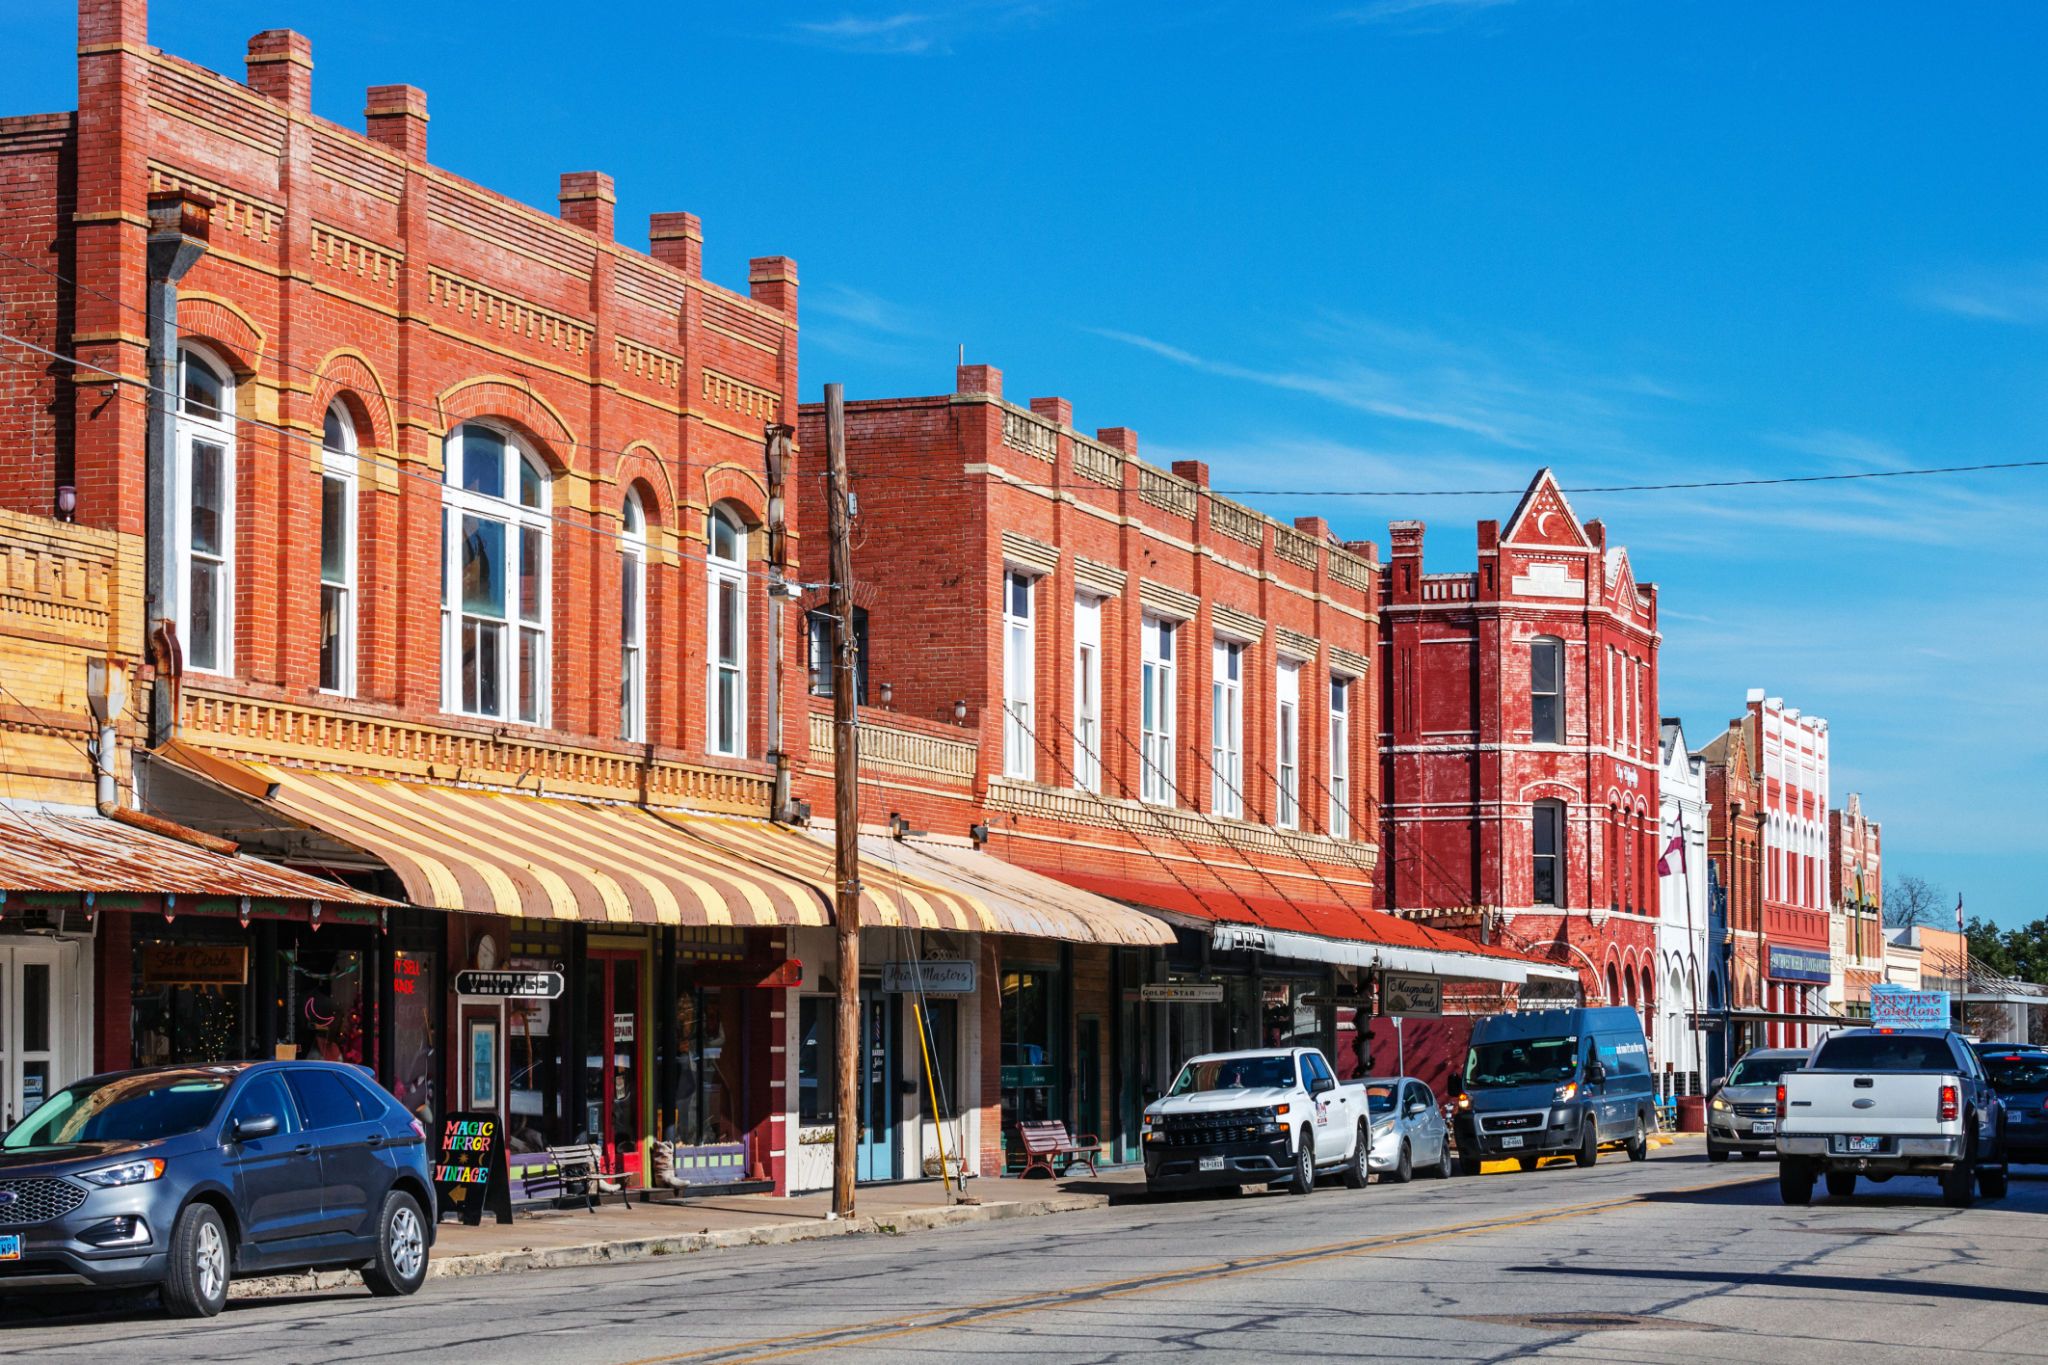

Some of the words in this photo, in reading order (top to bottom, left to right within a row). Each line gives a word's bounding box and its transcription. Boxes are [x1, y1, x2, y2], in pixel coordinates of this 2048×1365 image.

[403, 960, 421, 976] SELL
[920, 966, 968, 982] Masters
[467, 974, 550, 994] VINTAGE
[1398, 980, 1434, 997] Magnolia
[1143, 989, 1165, 998] GOLD
[1174, 989, 1195, 998] STAR
[1874, 994, 1942, 1004] PRINTING
[1875, 1005, 1941, 1017] Solutions
[614, 1026, 633, 1037] EPAIR
[445, 1120, 494, 1136] MAGIC
[1496, 1118, 1528, 1126] RAM
[442, 1135, 491, 1151] MIRROR
[435, 1165, 488, 1183] VINTAGE
